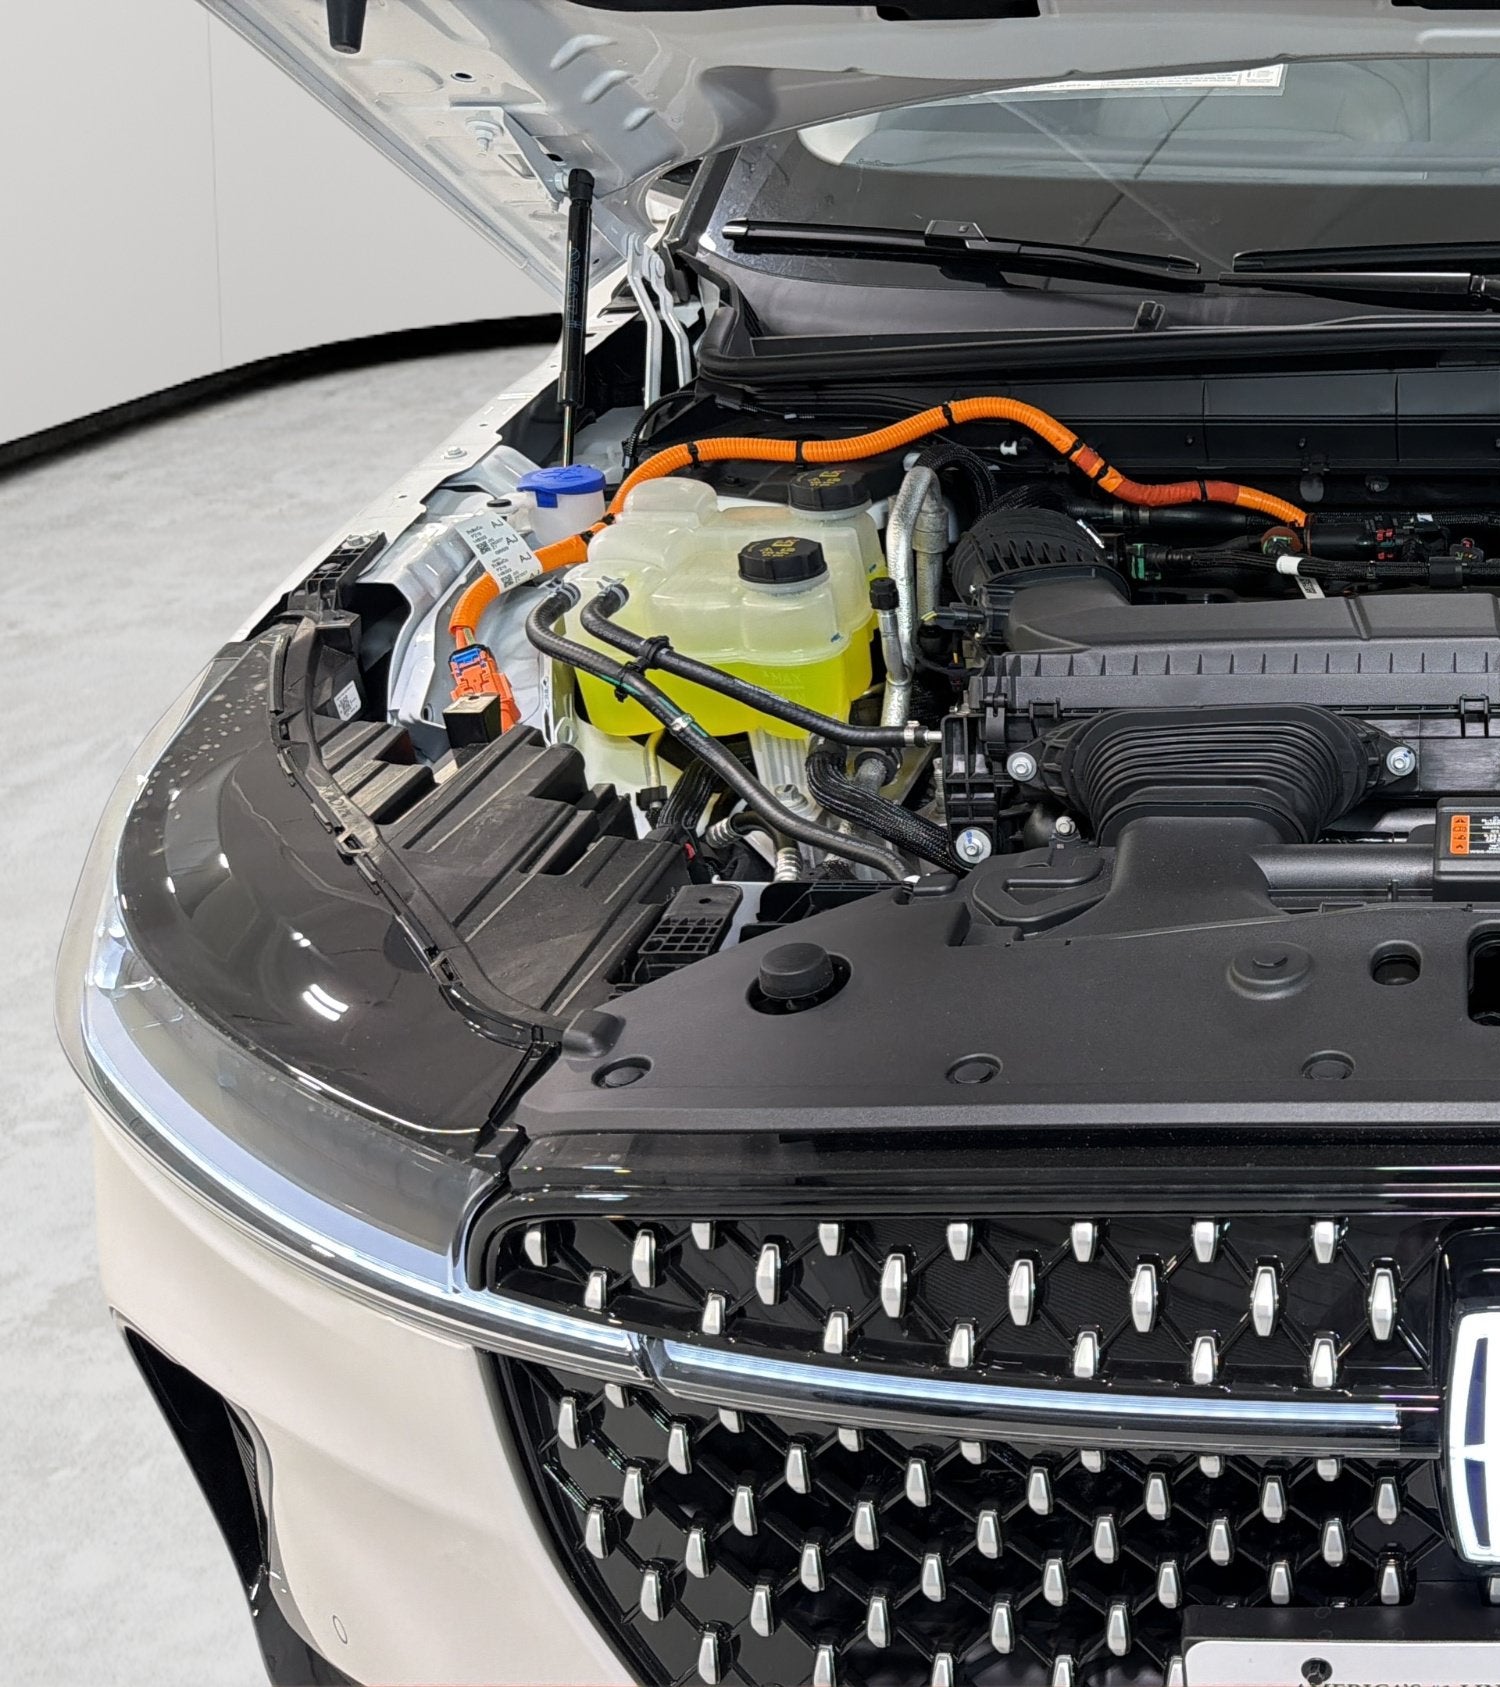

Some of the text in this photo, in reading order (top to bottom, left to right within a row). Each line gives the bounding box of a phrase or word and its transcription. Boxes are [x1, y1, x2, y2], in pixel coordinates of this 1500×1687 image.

[491, 519, 504, 528] AJ
[506, 534, 519, 546] AJ
[519, 552, 532, 563] AJ
